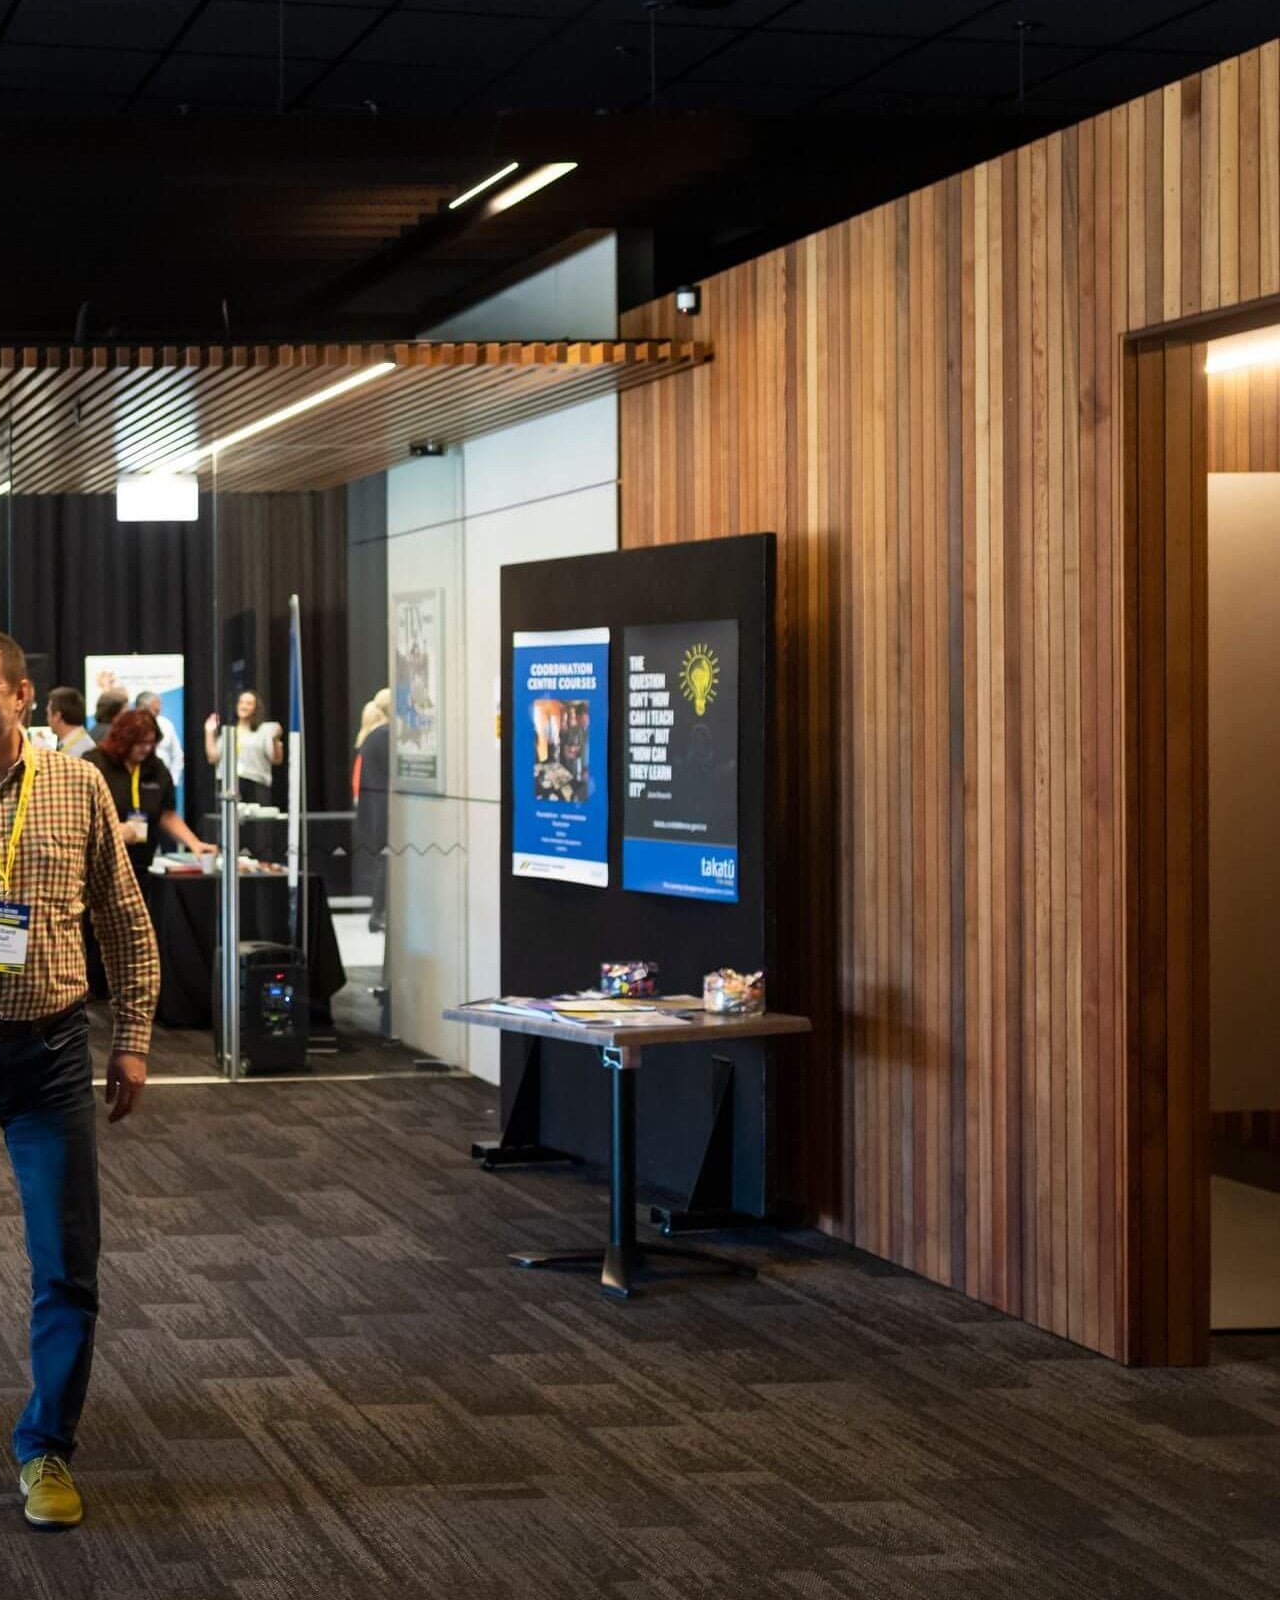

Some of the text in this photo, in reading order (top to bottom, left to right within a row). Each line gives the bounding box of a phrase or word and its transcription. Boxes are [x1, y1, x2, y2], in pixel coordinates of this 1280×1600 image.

[530, 662, 593, 677] COORDINATION
[527, 675, 597, 691] CENTRE COURSES
